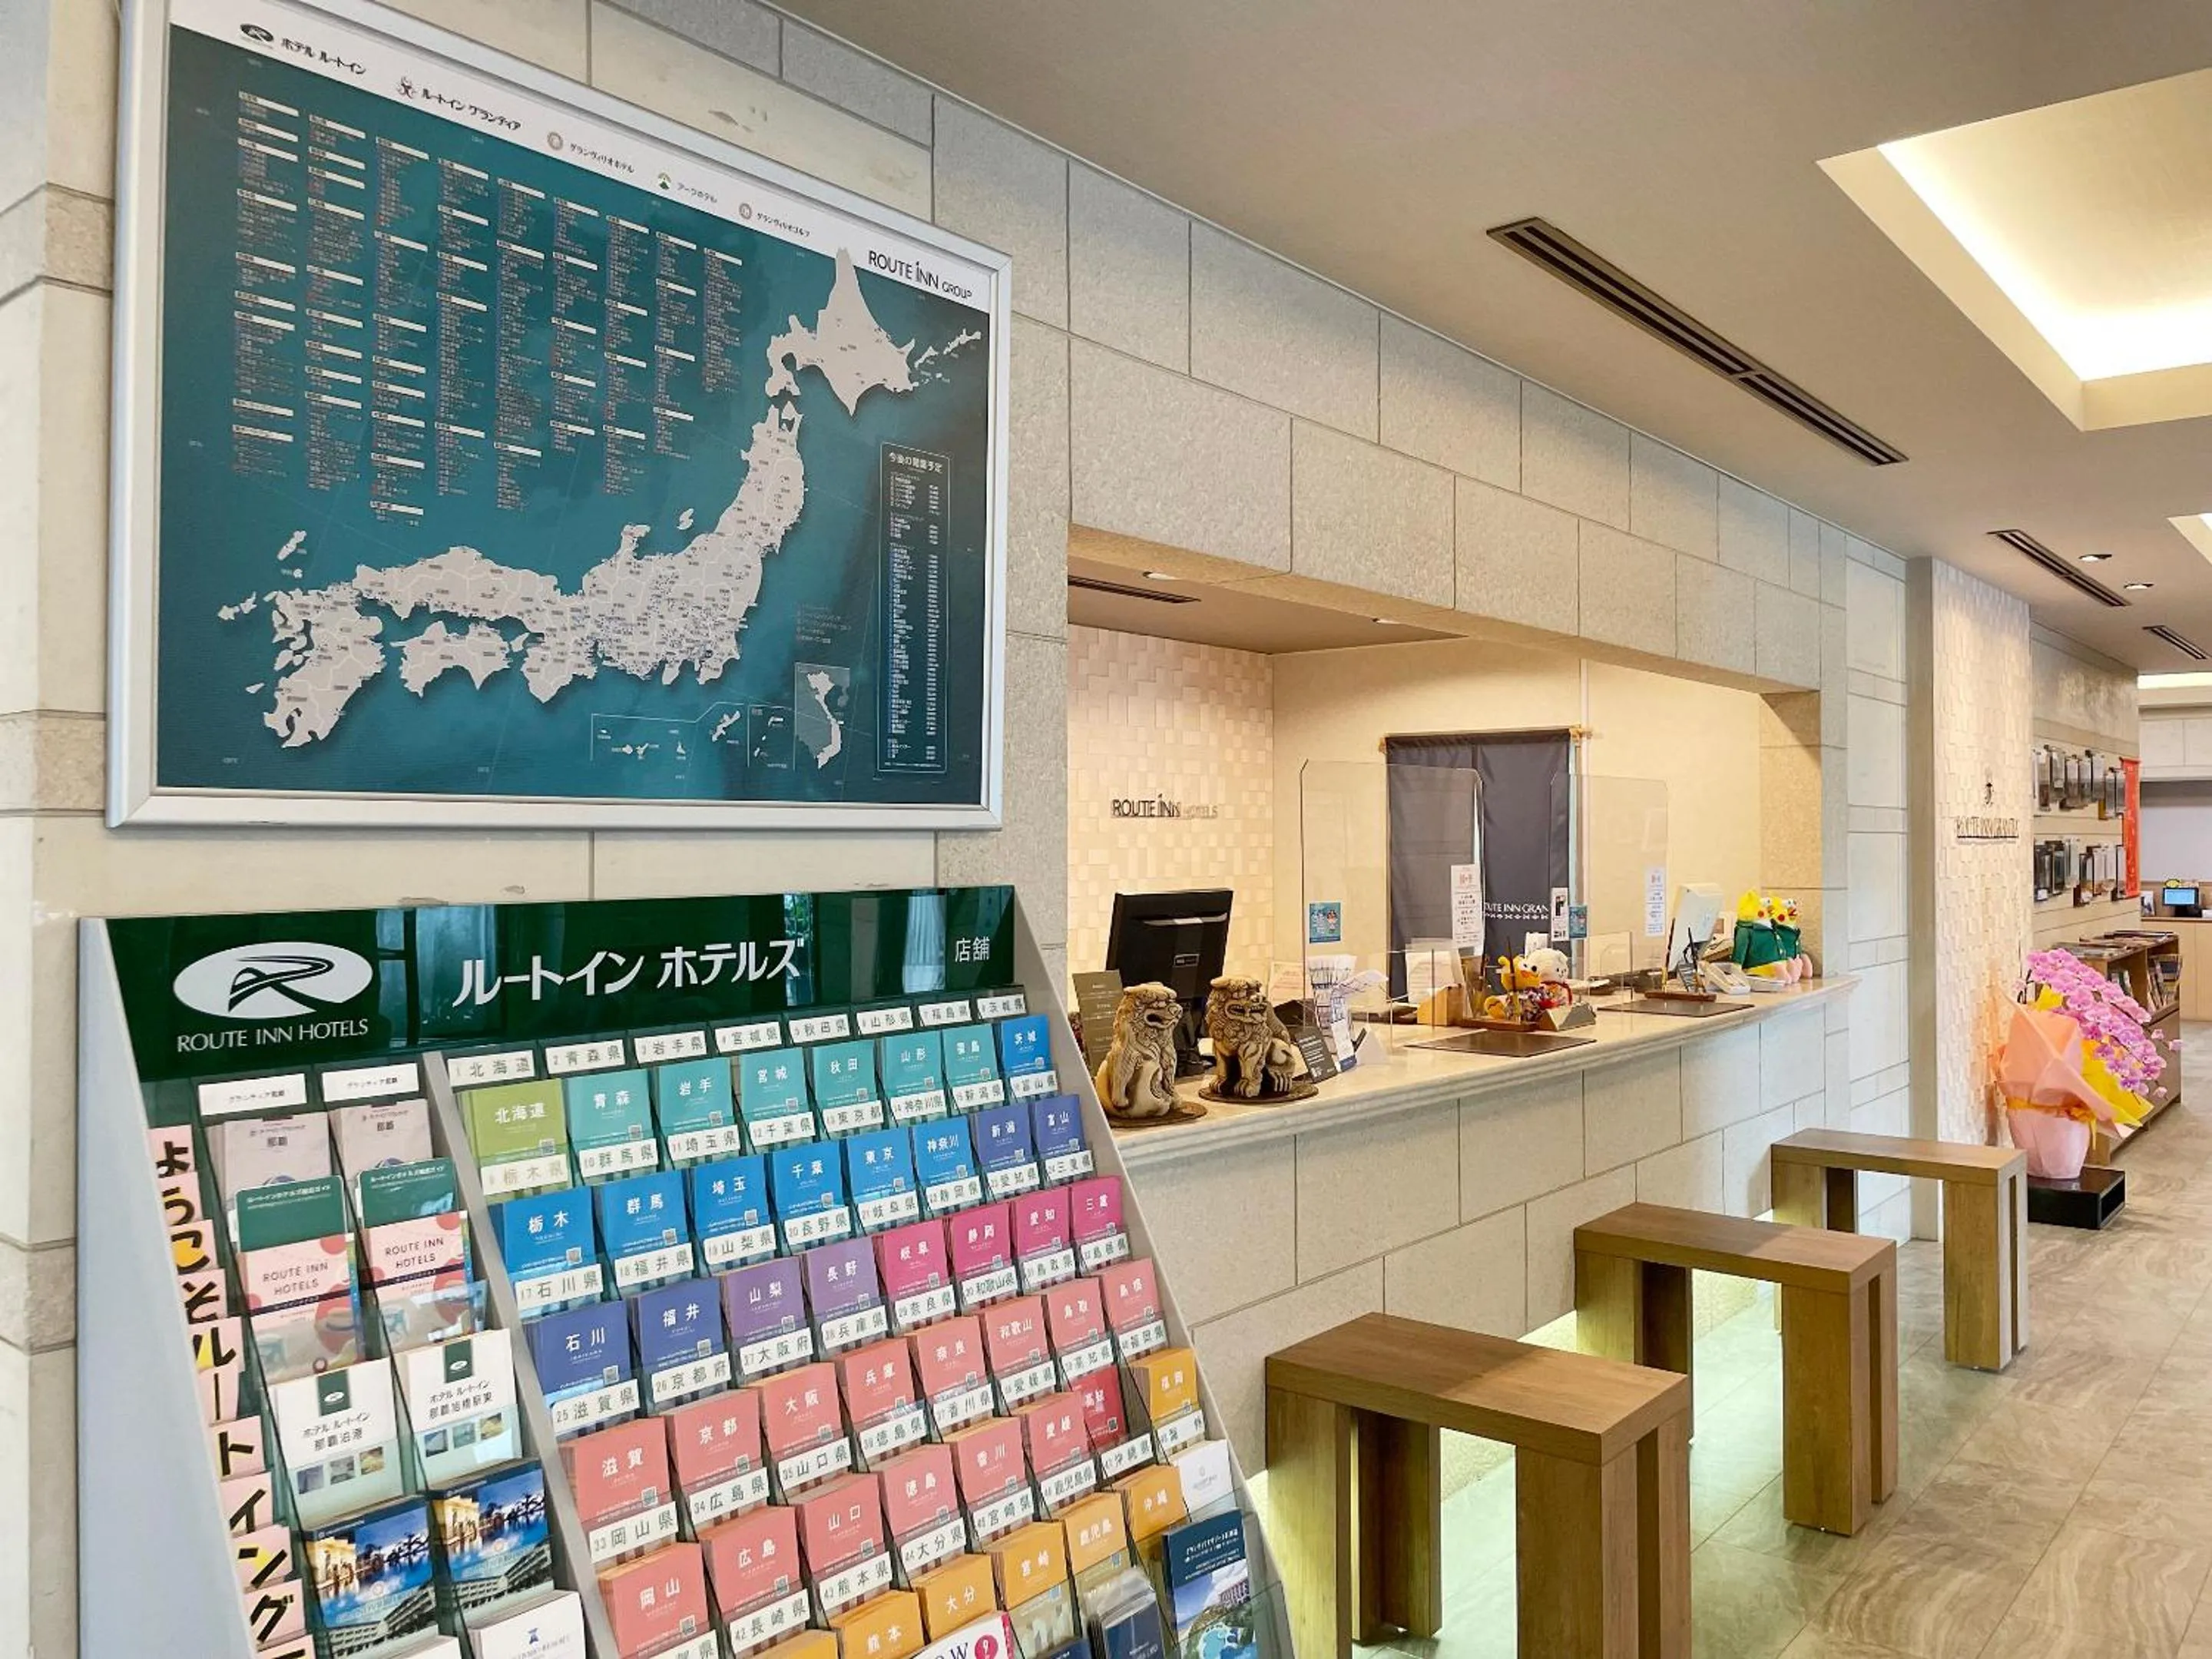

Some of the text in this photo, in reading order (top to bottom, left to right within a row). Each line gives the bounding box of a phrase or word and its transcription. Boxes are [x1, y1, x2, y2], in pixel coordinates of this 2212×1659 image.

[868, 250, 912, 280] ROUTE
[1111, 799, 1156, 818] ROUTE
[954, 935, 991, 964] 店舗
[452, 936, 806, 1008] ルートイン ホテルズ
[177, 1018, 369, 1053] ROUTE INN HOTELS
[830, 1058, 859, 1075] 秋田
[900, 1046, 927, 1064] 山形
[469, 1057, 531, 1078] 北海道
[757, 1065, 788, 1084] 宮城
[678, 1077, 713, 1097] 岩手
[593, 1089, 631, 1109] 青森
[494, 1101, 548, 1124] 北海道
[926, 1132, 960, 1153] 神奈川
[865, 1146, 895, 1164] 東京
[791, 1159, 824, 1177] 千葉
[711, 1174, 747, 1196] 埼玉
[626, 1193, 664, 1215] 群馬
[528, 1210, 569, 1233] 栃木
[1029, 1208, 1055, 1227] 愛知
[386, 1237, 445, 1257] ROUTE INN
[263, 1261, 329, 1282] ROUTE INN
[396, 1253, 436, 1269] HOTELS
[826, 1260, 858, 1283] 長野
[273, 1278, 320, 1296] HOTELS
[536, 1270, 598, 1299] 石川県
[749, 1281, 783, 1304] 山梨
[662, 1303, 700, 1328] 福井
[565, 1327, 606, 1353] 石川
[999, 1319, 1033, 1340] 和歌山
[935, 1339, 966, 1363] 奈良
[865, 1363, 896, 1387] 兵庫
[572, 1389, 635, 1421] 滋賀県
[785, 1389, 820, 1416] 大阪
[698, 1416, 738, 1445] 京都
[601, 1448, 645, 1479] 滋賀
[796, 1445, 851, 1477] 山口県
[709, 1476, 766, 1512] 広島県
[611, 1509, 675, 1548] 岡山県
[827, 1505, 862, 1531] 山口
[737, 1538, 777, 1568] 広島
[639, 1578, 681, 1609] 岡山
[945, 1585, 976, 1614] 大分
